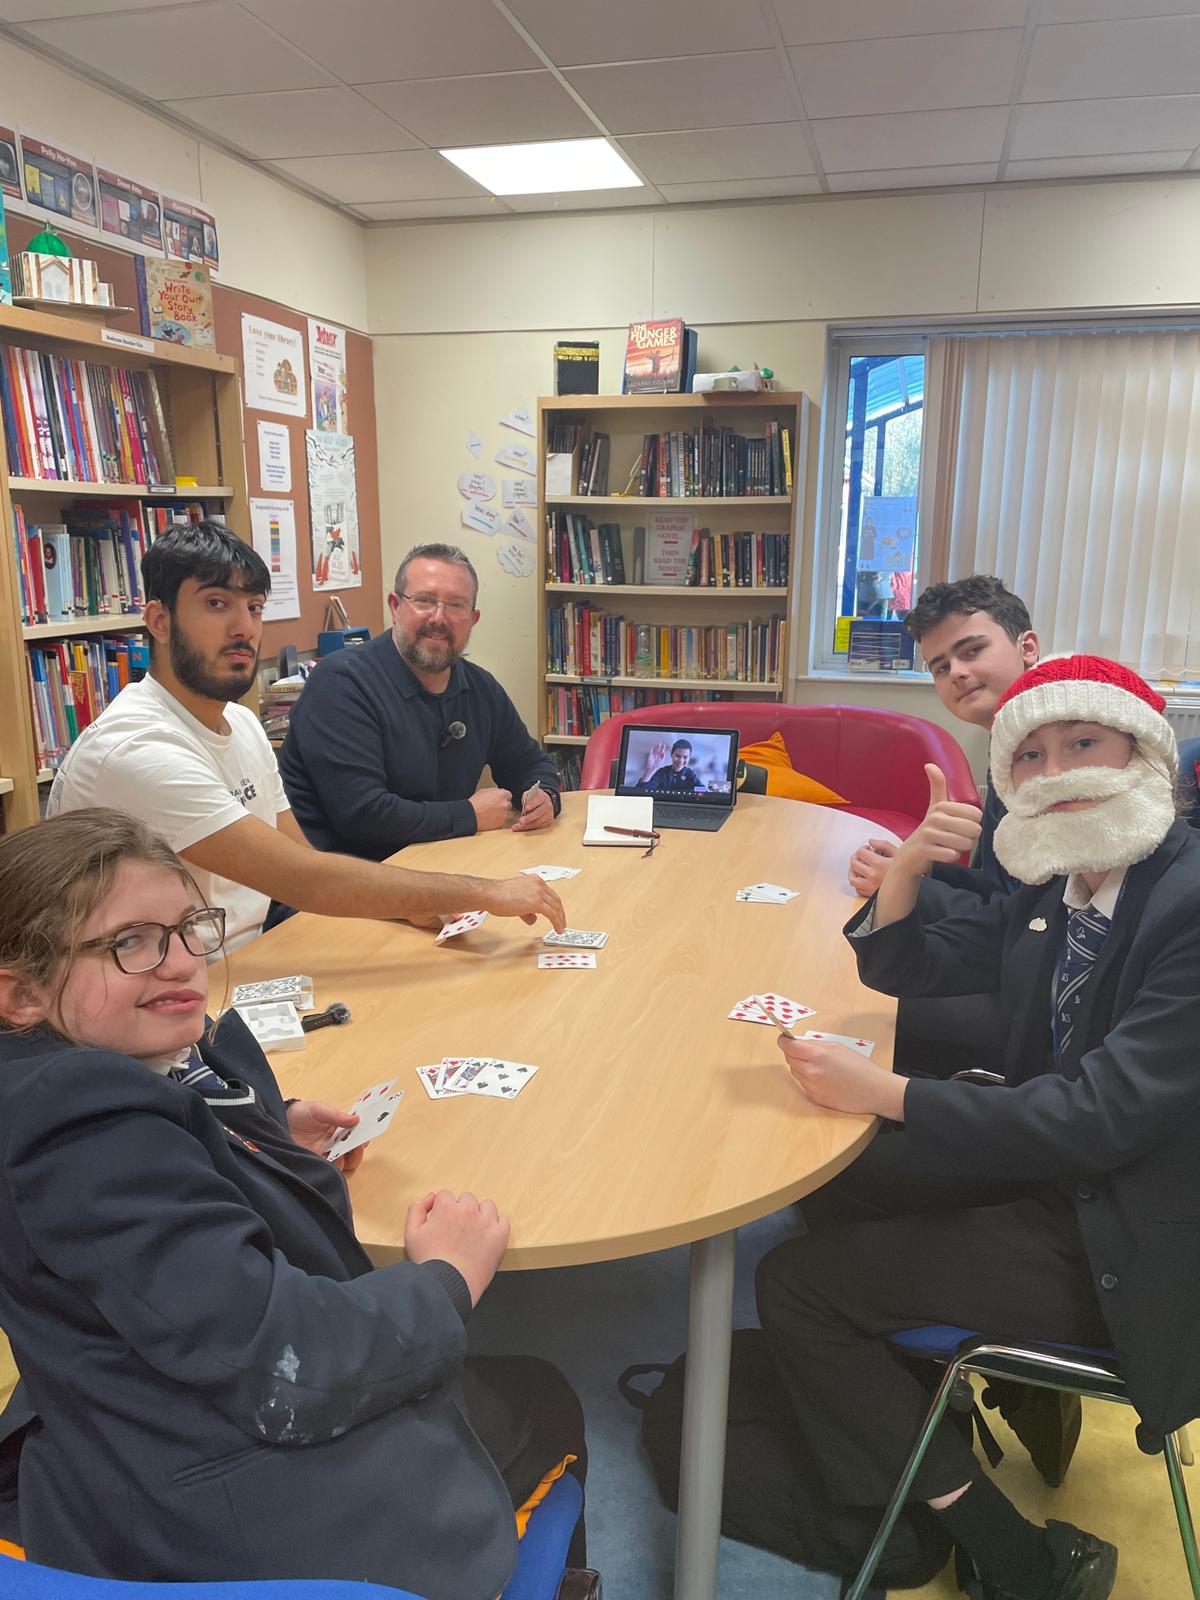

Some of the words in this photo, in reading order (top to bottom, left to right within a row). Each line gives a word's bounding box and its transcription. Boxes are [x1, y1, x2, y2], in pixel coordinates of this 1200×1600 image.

[164, 281, 191, 294] Write
[158, 290, 180, 301] Your
[182, 294, 202, 304] Own
[167, 300, 193, 314] Story
[174, 311, 198, 322] Book
[630, 326, 678, 342] HUNGER
[633, 324, 647, 332] THE
[636, 336, 676, 349] GAMES
